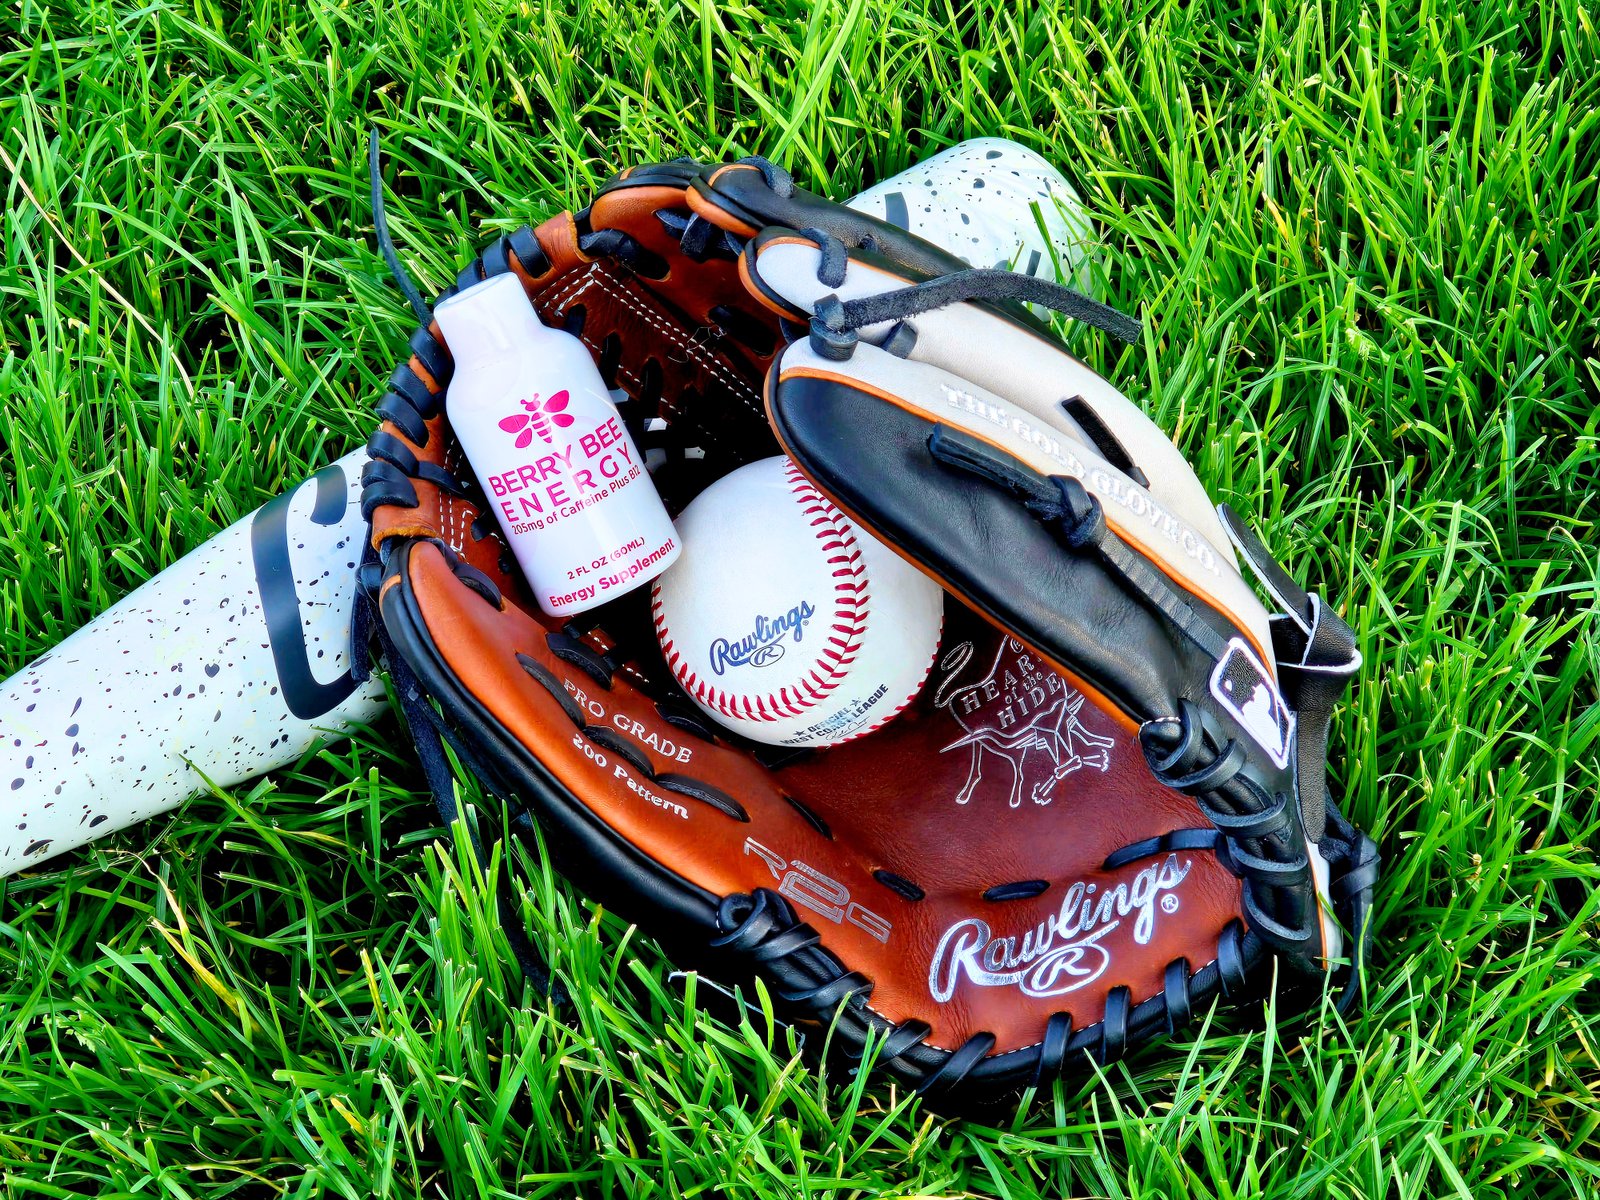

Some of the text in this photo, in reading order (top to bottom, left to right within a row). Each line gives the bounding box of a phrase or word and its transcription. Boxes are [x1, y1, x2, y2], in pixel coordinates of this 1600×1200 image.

[488, 416, 622, 497] BERRY BEE
[500, 442, 632, 522] ENERGY
[940, 383, 1008, 429] THE
[1012, 417, 1087, 479] GOLD
[1091, 470, 1184, 540] GLOVE
[511, 464, 641, 535] 205mg of Caffeine Plus B12
[549, 538, 675, 607] Energy Supplement
[567, 536, 645, 580] 2 FL OZ (60ML)
[709, 600, 815, 676] Rawlings
[780, 733, 814, 745] WEST
[815, 717, 852, 737] COAST
[851, 683, 888, 717] LEAGUE
[808, 706, 850, 732] OFFICIAL
[961, 652, 1042, 715] HEAR
[997, 672, 1061, 730] HIDE
[1004, 672, 1043, 704] of the
[563, 678, 693, 763] PRO GRADE
[573, 733, 689, 819] 200 Pattern
[928, 853, 1192, 1003] Rawlings
